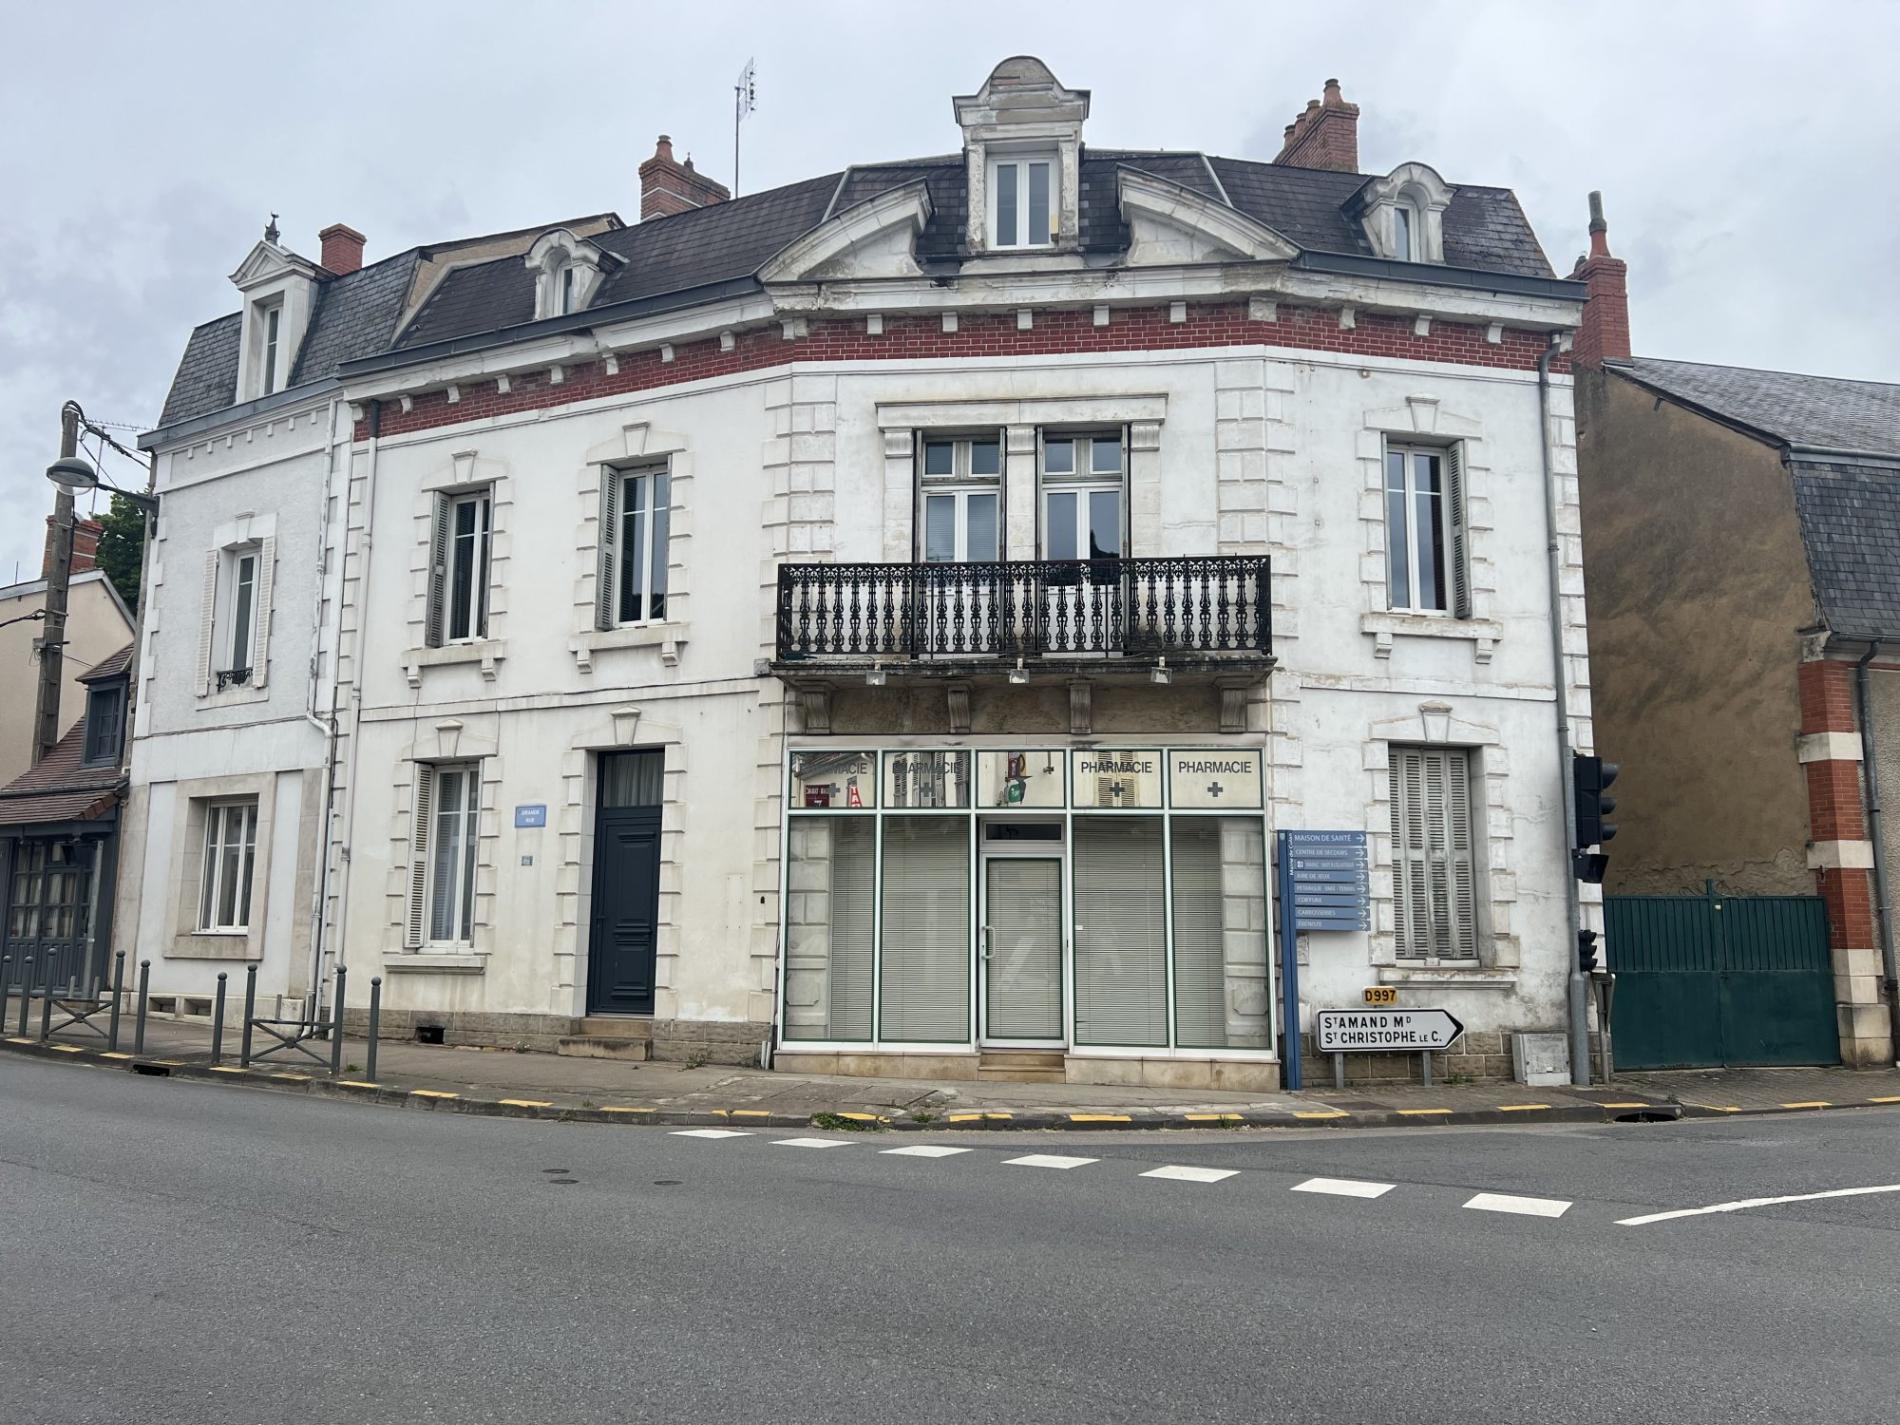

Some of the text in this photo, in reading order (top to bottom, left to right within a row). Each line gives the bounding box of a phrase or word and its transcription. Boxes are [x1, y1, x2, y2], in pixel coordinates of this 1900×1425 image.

[1081, 761, 1153, 773] PHARMACIE
[1178, 761, 1252, 773] PHARMACIE
[1294, 833, 1352, 842] MAISON DE SANTÉ
[1365, 990, 1396, 1001] D997
[1338, 1016, 1387, 1029] AMAND
[1340, 1031, 1417, 1044] CHRISTOPHE
[1419, 1034, 1428, 1042] LE
[1431, 1030, 1442, 1043] C.
